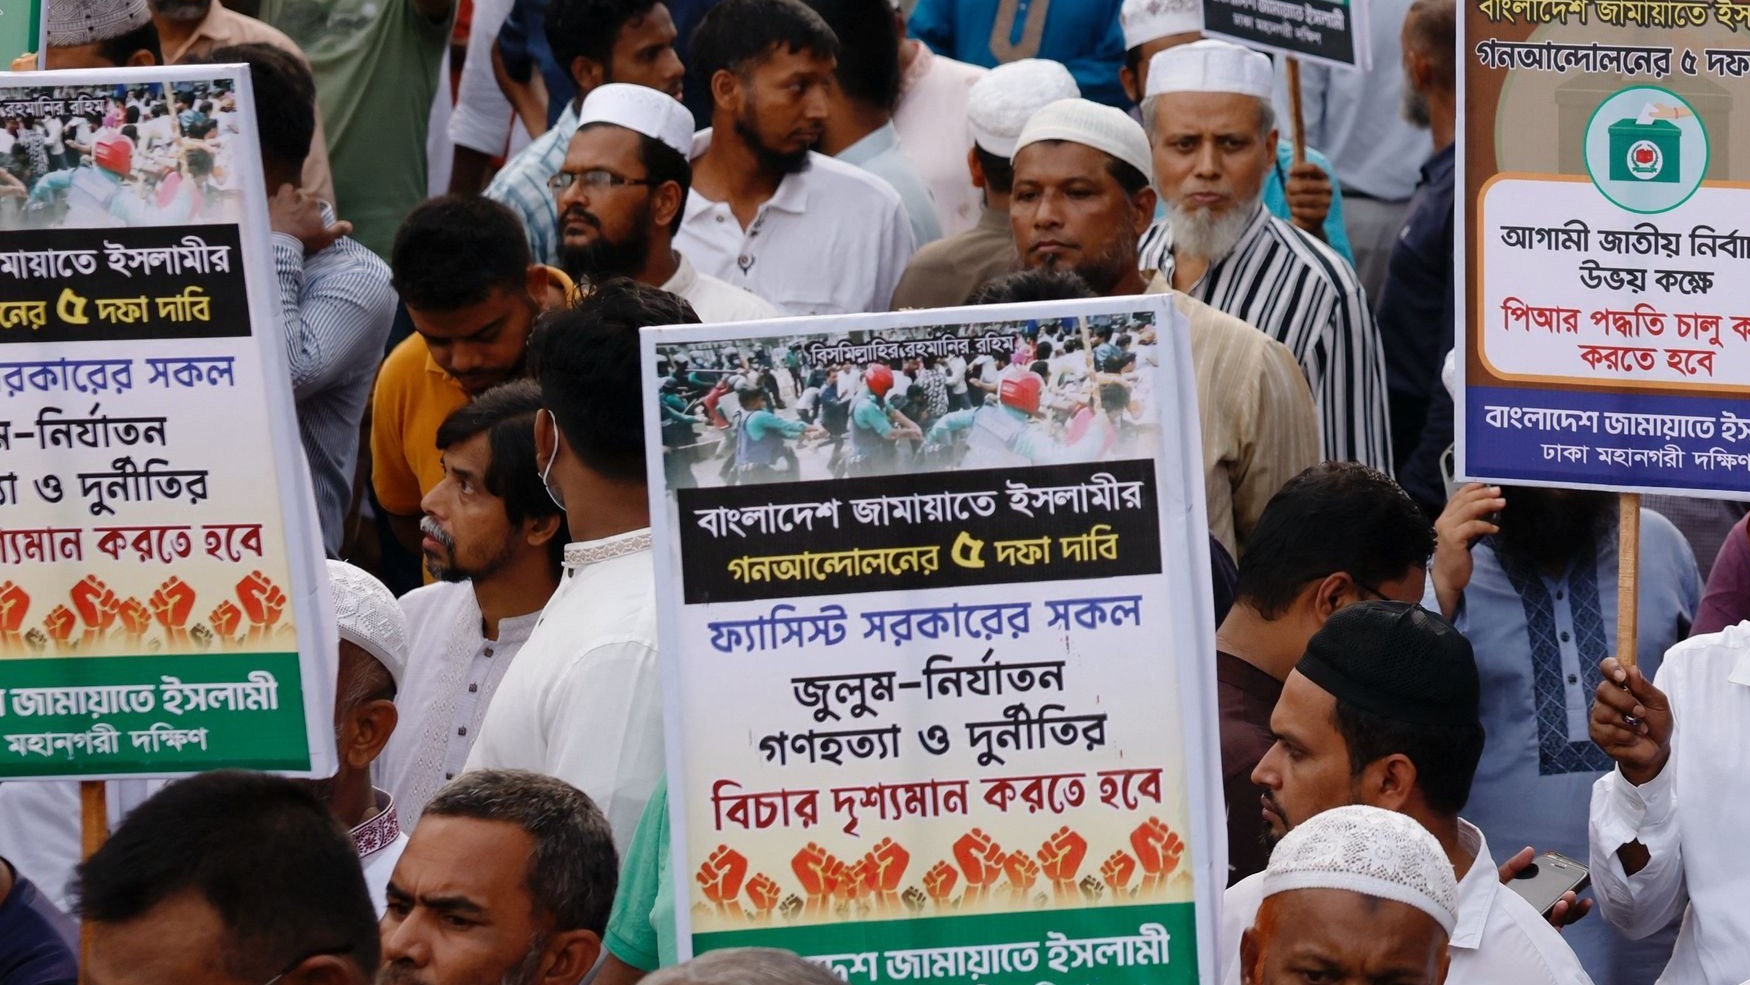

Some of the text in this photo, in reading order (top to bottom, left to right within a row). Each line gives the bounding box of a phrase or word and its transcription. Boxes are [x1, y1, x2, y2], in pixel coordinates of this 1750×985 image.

[1475, 38, 1671, 75] গনআন্দোলনের
[1681, 48, 1696, 75] ৫
[102, 238, 234, 276] ইসলামীর
[1500, 219, 1590, 252] আগামী
[1597, 222, 1680, 258] জাতীয়
[1579, 259, 1715, 295] উভয় কক্ষে
[57, 289, 87, 324] ৫
[96, 296, 147, 322] দফা
[155, 286, 210, 321] দাবি
[1500, 297, 1581, 334] পিআর
[1590, 303, 1667, 337] পদ্ধতি
[1674, 312, 1723, 348] চালু
[905, 335, 970, 360] রহমানির
[974, 332, 1015, 356] রহিম
[1579, 345, 1716, 376] করতে হবে
[0, 356, 235, 397] রকারের সকল
[1484, 406, 1599, 433] বাংলাদেশ
[1603, 412, 1716, 441] জামায়াতে
[1540, 443, 1590, 464] ঢাকা
[1596, 445, 1684, 468] মহানগরী
[34, 474, 63, 503] ও
[77, 456, 208, 516] দুর্নীতির
[694, 472, 1144, 537] বাংলাদেশ জামায়াতে ইসলামীর
[94, 526, 191, 563] করতে
[202, 524, 262, 562] হবে
[728, 524, 1118, 583] গনআন্দোলনের ৫ দফা দাবি
[707, 596, 1142, 652] ফ্যাসিস্ট সরকারের সকল
[10, 684, 155, 719] জামায়াতে
[160, 670, 278, 715] ইসলামী
[791, 648, 1066, 722] জুলুম-নির্যাতন
[3, 722, 208, 759] মহানগরী দক্ষিণ
[759, 703, 1107, 766] গণহত্যা ও দুর্নীতির
[711, 769, 1163, 836] বিচার দৃশ্যমান করতে হবে
[884, 941, 1040, 979] জামায়াতে
[1045, 923, 1170, 972] ইসলামী
